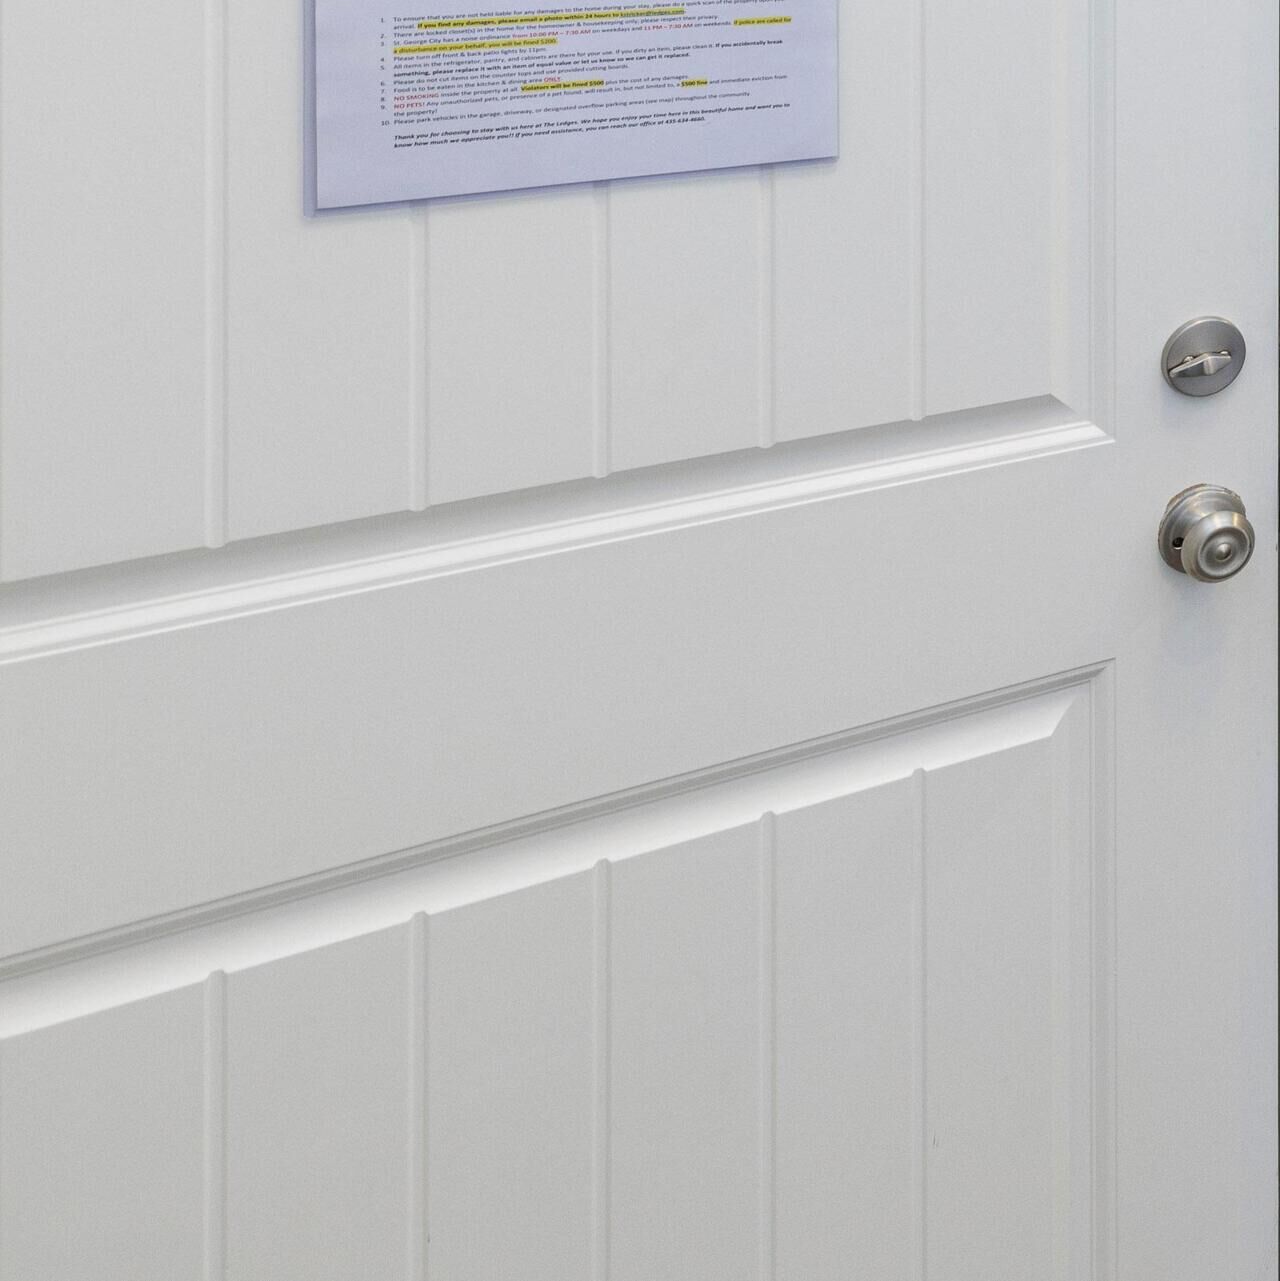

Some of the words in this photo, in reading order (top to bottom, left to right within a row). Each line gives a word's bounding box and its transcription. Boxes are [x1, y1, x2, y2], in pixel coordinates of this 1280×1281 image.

[394, 70, 430, 78] something,
[455, 66, 479, 74] replace
[536, 61, 553, 69] equal
[664, 52, 690, 60] replaced.
[508, 79, 527, 87] dining
[441, 129, 470, 137] choosing
[556, 120, 578, 128] Ledges.
[592, 117, 608, 125] hope
[461, 135, 495, 143] appreciate
[551, 127, 584, 135] assistance,
